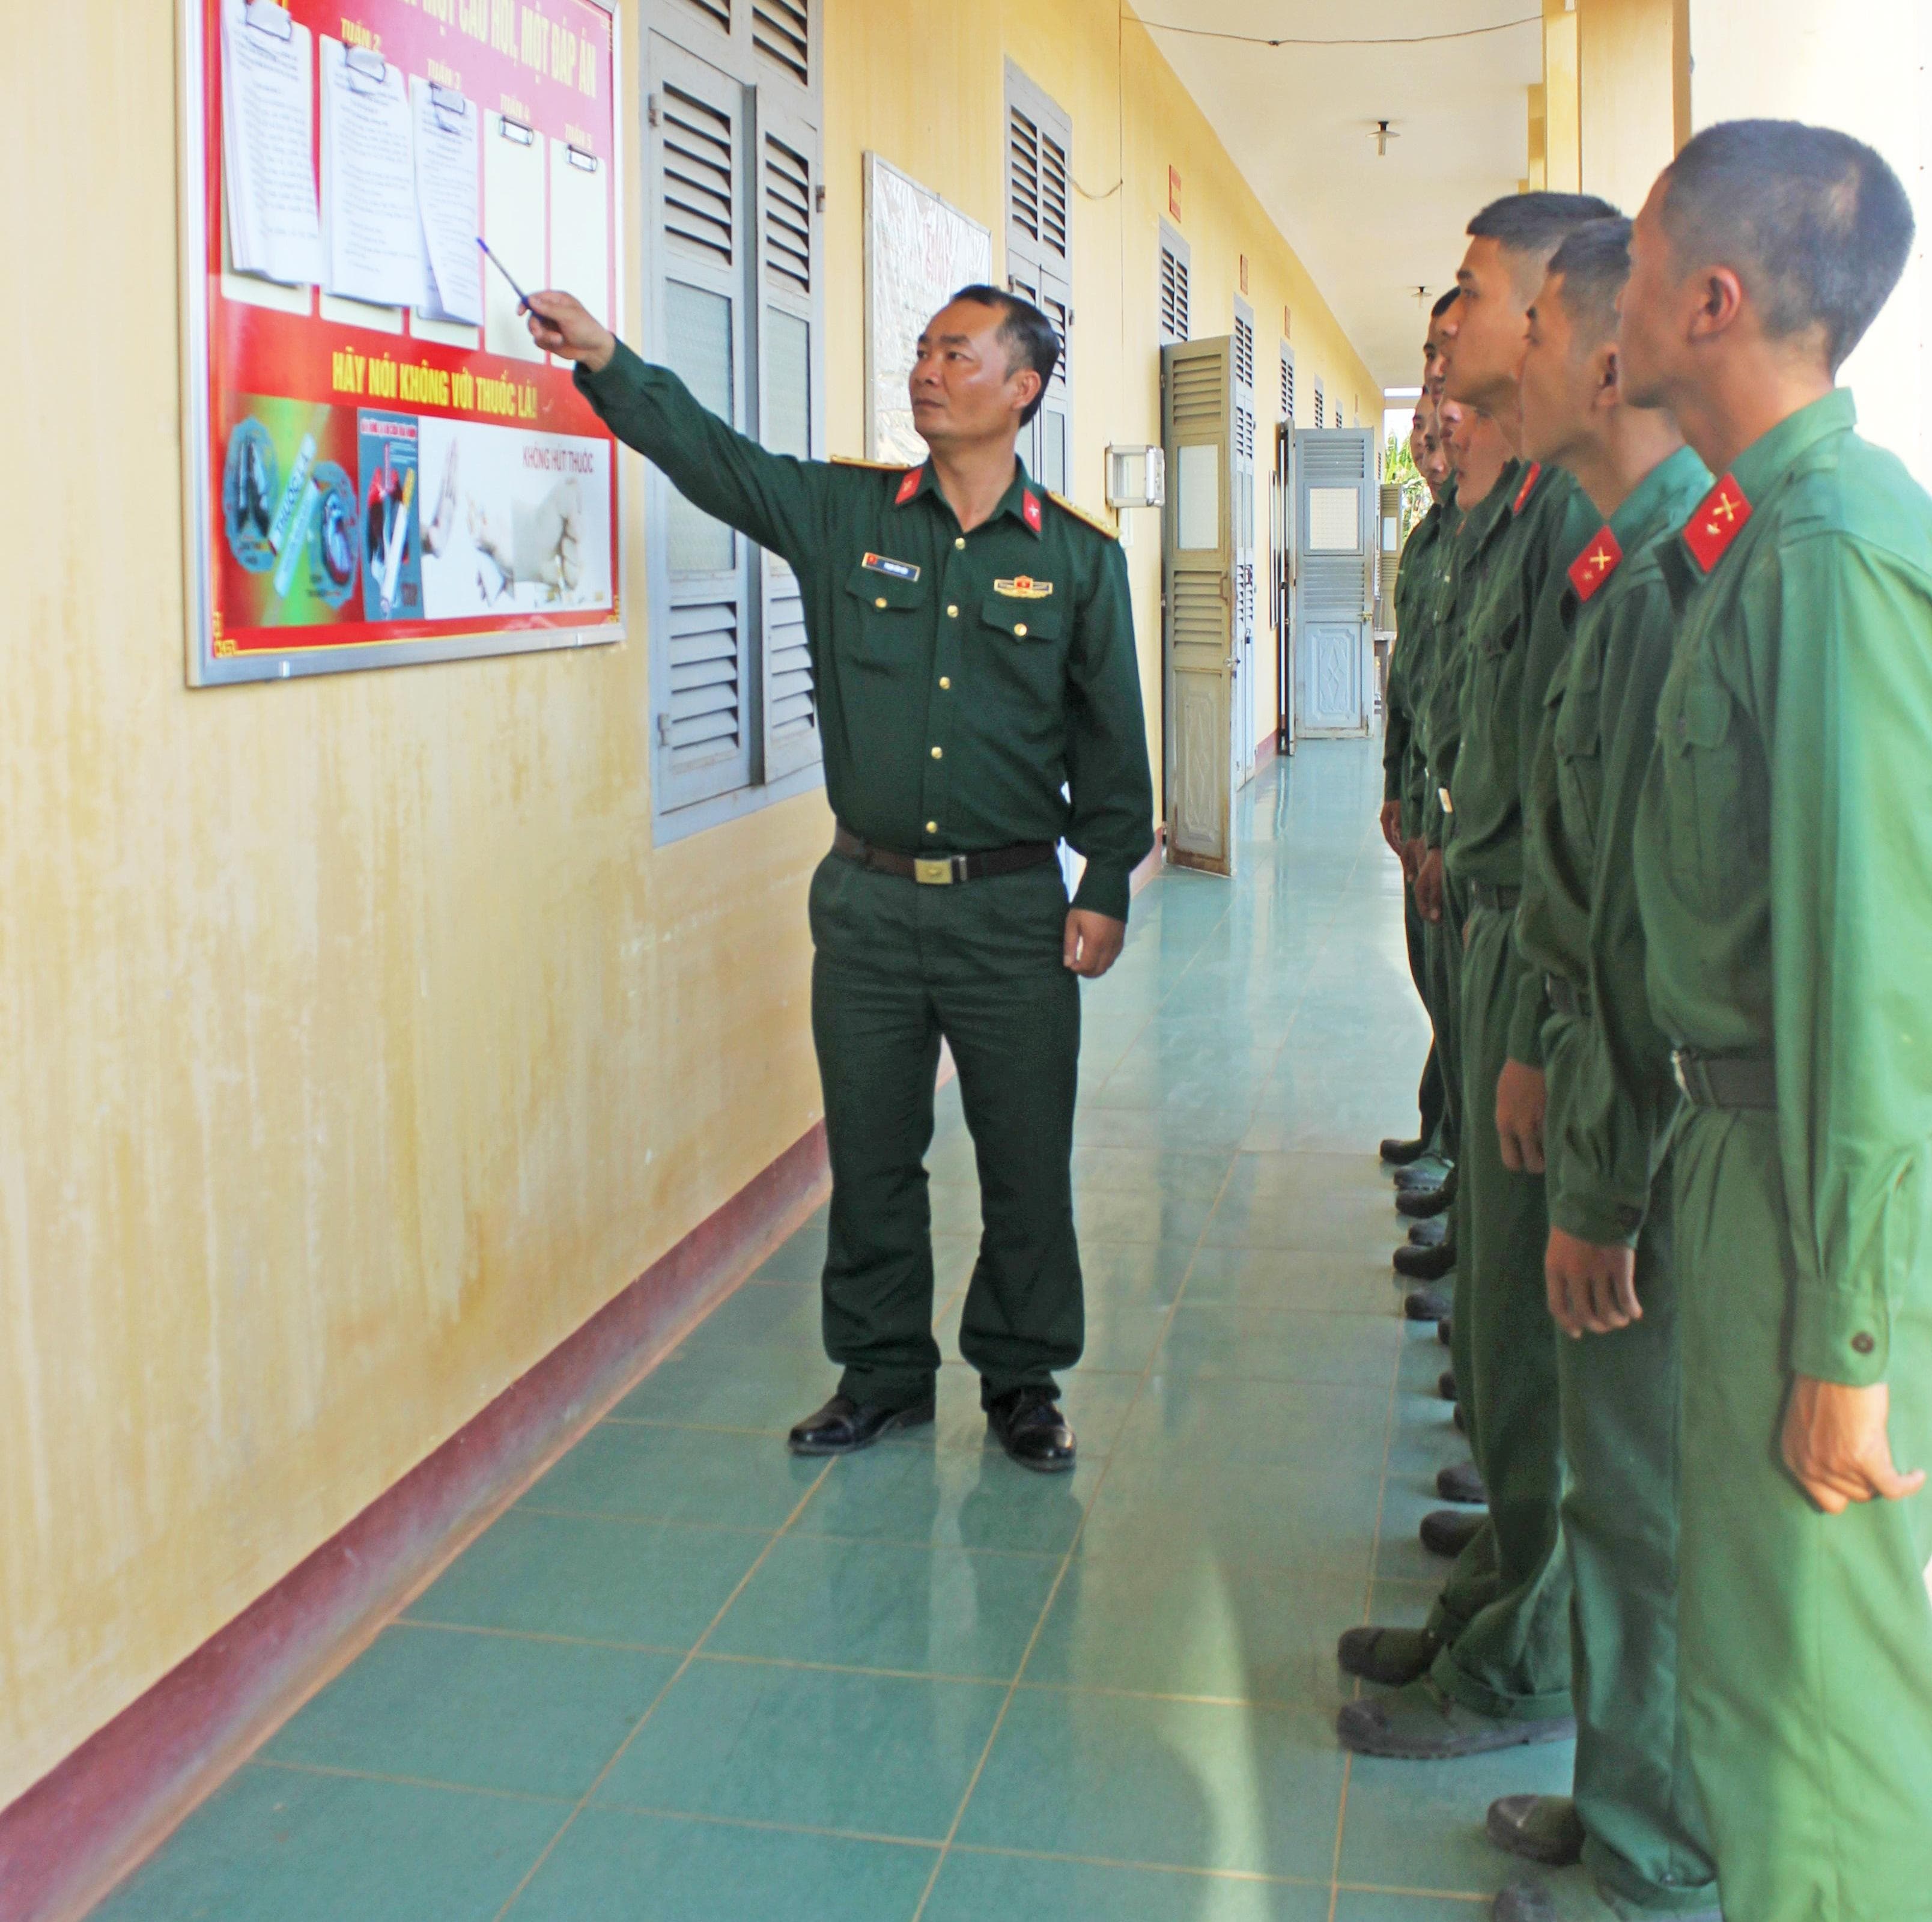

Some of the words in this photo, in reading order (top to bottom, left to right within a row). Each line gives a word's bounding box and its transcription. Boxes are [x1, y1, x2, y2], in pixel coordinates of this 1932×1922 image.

[371, 33, 381, 52] 2
[520, 0, 549, 84] MỘT
[550, 16, 577, 88] ĐÁP
[579, 26, 596, 99] ÁN
[332, 345, 365, 394] HÃY
[368, 351, 396, 399] NÓI
[399, 359, 449, 406] KHÔNG
[451, 366, 473, 410] VỚI
[475, 369, 515, 416] THUỐC
